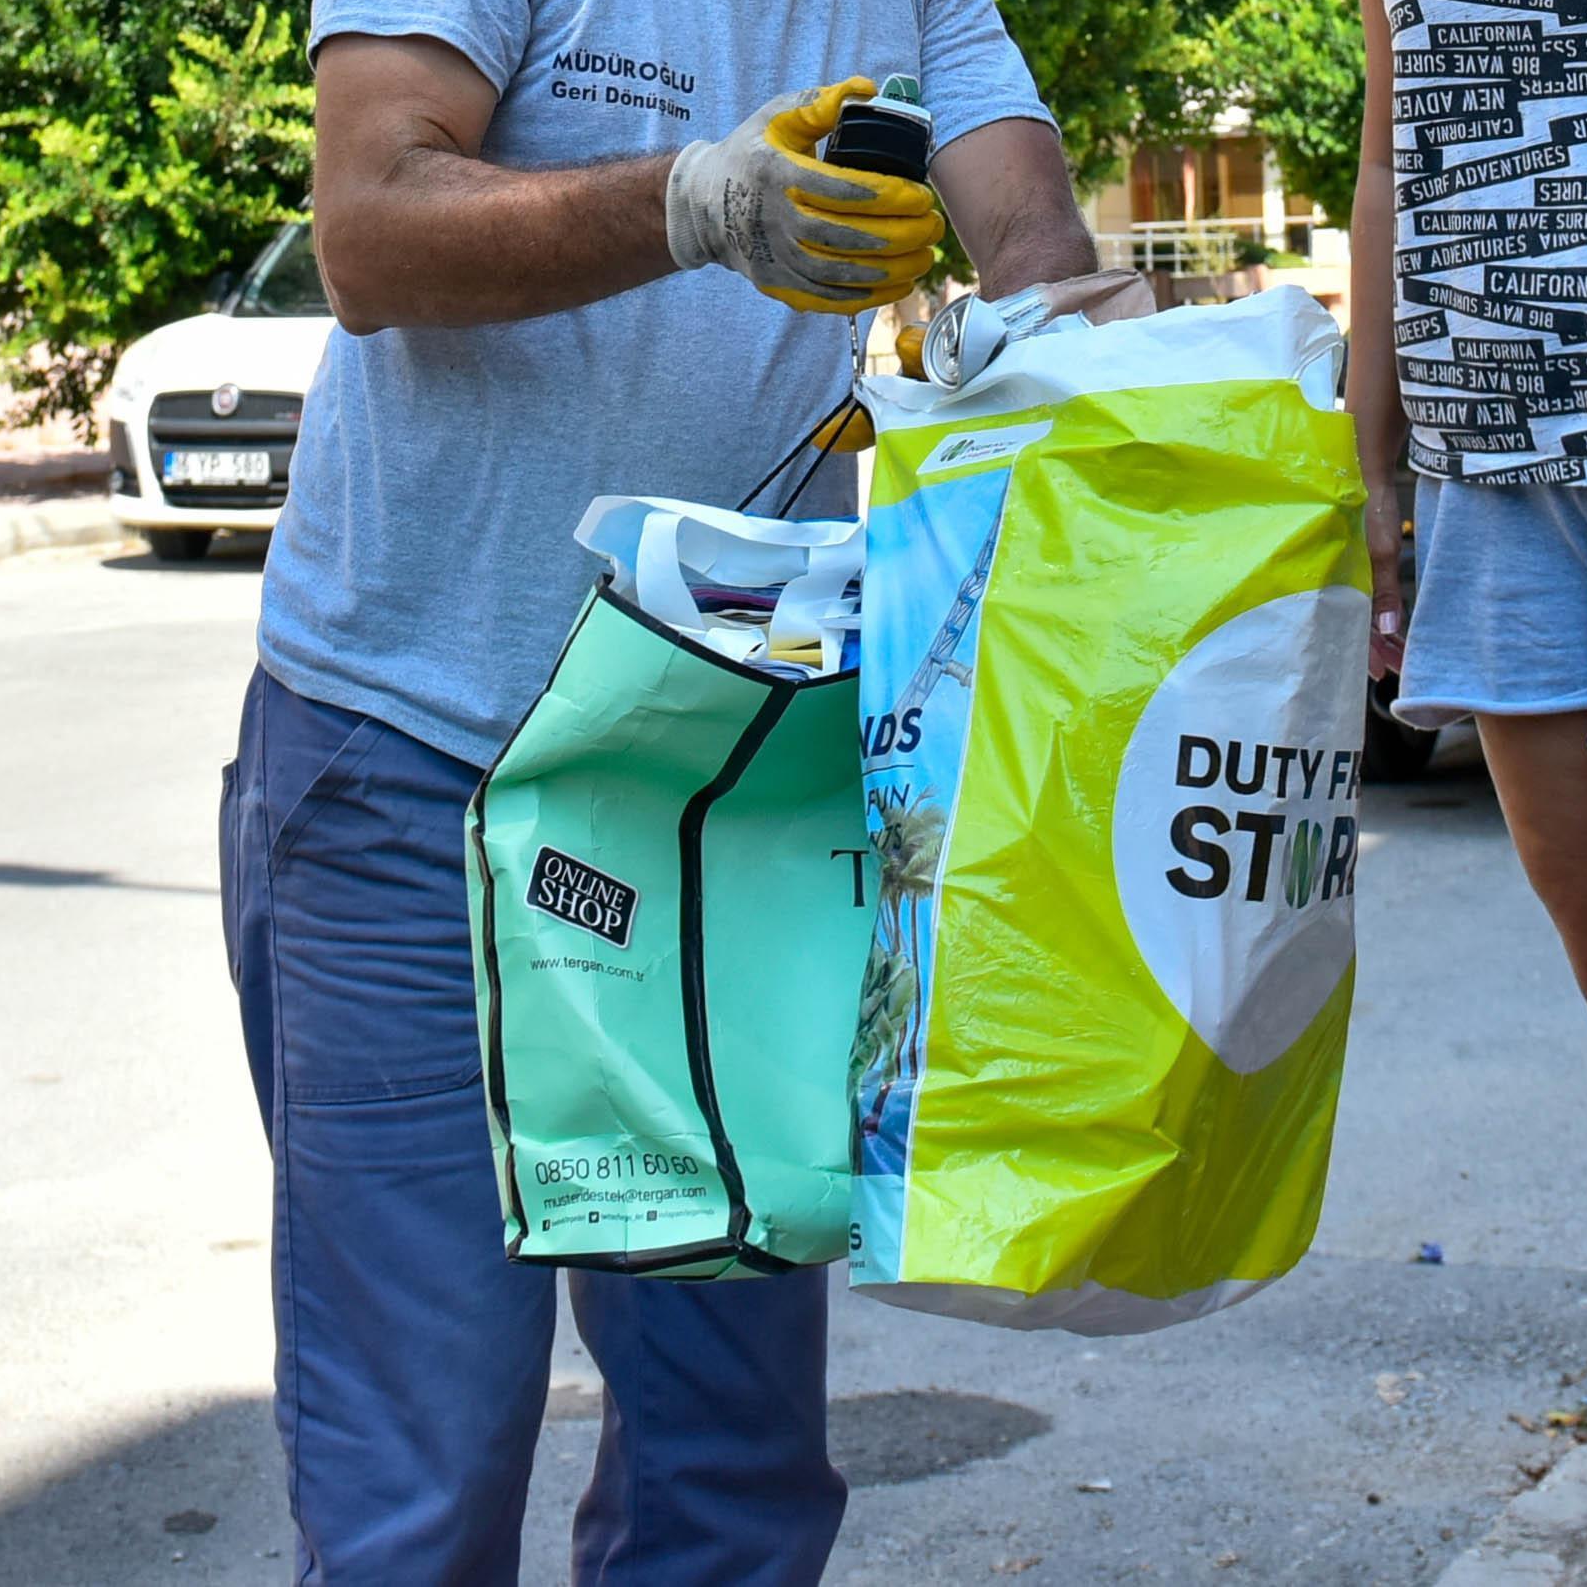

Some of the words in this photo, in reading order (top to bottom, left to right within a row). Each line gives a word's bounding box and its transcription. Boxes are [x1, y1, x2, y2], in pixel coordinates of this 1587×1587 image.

[1437, 24, 1533, 45] CALIFORNIA
[552, 48, 695, 94] MÜDÜROĞLU
[1454, 54, 1503, 74] WAVE
[1513, 55, 1540, 75] BIG
[551, 80, 597, 102] Geri
[1462, 87, 1505, 111] NEW
[1425, 117, 1514, 144] CALIFORNIA
[1411, 174, 1450, 201] SURF
[1454, 145, 1566, 192] ADVENTURES
[1506, 212, 1550, 231] WAVE
[1483, 299, 1524, 325] WAVE
[1529, 309, 1554, 329] BIG
[1458, 342, 1537, 360] CALIFORNIA
[1408, 361, 1464, 385] SURFING
[1468, 366, 1511, 391] WAVE
[1516, 375, 1545, 395] BIG
[1476, 402, 1517, 426] NEW
[1176, 735, 1324, 800] DUTY
[545, 856, 626, 912] ONLINE
[538, 878, 623, 936] SHOP
[529, 956, 645, 982] www.tergan.com.tr
[535, 1158, 590, 1185] 0850
[596, 1153, 635, 1180] 811
